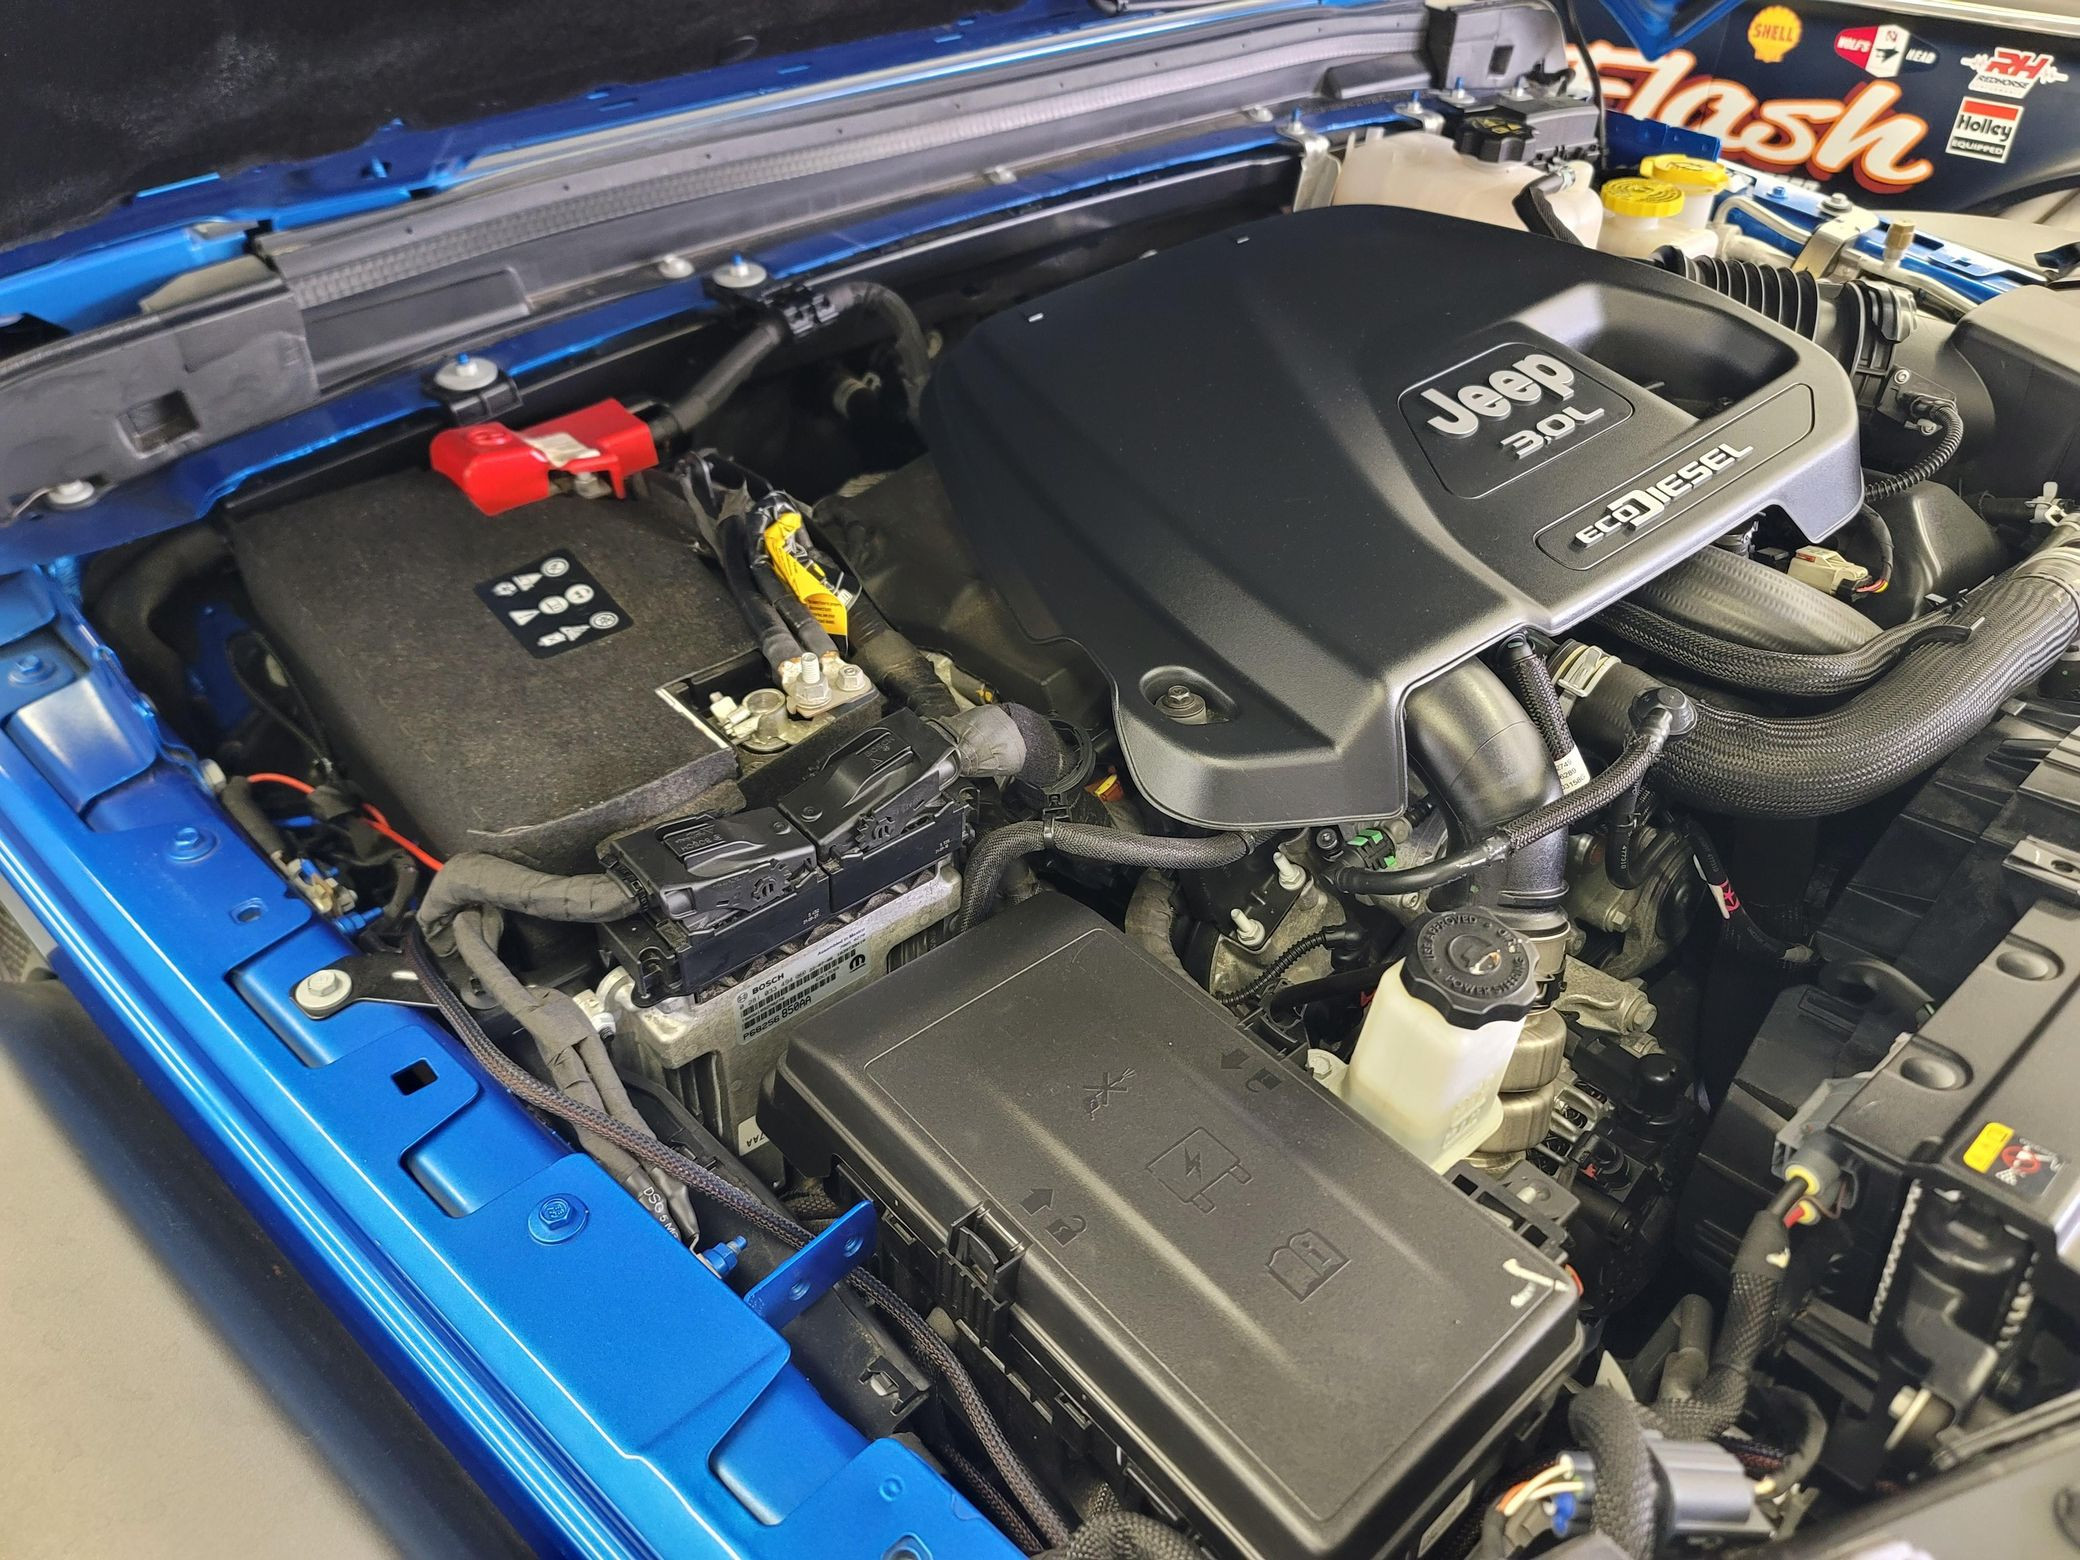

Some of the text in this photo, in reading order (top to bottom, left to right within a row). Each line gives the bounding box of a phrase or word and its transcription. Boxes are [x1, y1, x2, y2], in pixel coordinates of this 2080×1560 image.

[1752, 23, 1793, 42] SHELL
[1905, 48, 1937, 65] HEAD
[1985, 49, 2048, 80] RH
[1977, 75, 2030, 89] REDHORSE
[1563, 40, 1934, 192] Flash
[1955, 113, 2012, 142] Holley
[1951, 138, 2004, 157] EQUIPPED
[1420, 354, 1575, 438] Jeep
[1500, 405, 1605, 459] 3.0L
[752, 973, 785, 995] BOSCH
[1446, 974, 1492, 997] POWER
[743, 1016, 780, 1040] P68256
[782, 996, 812, 1018] 850AA
